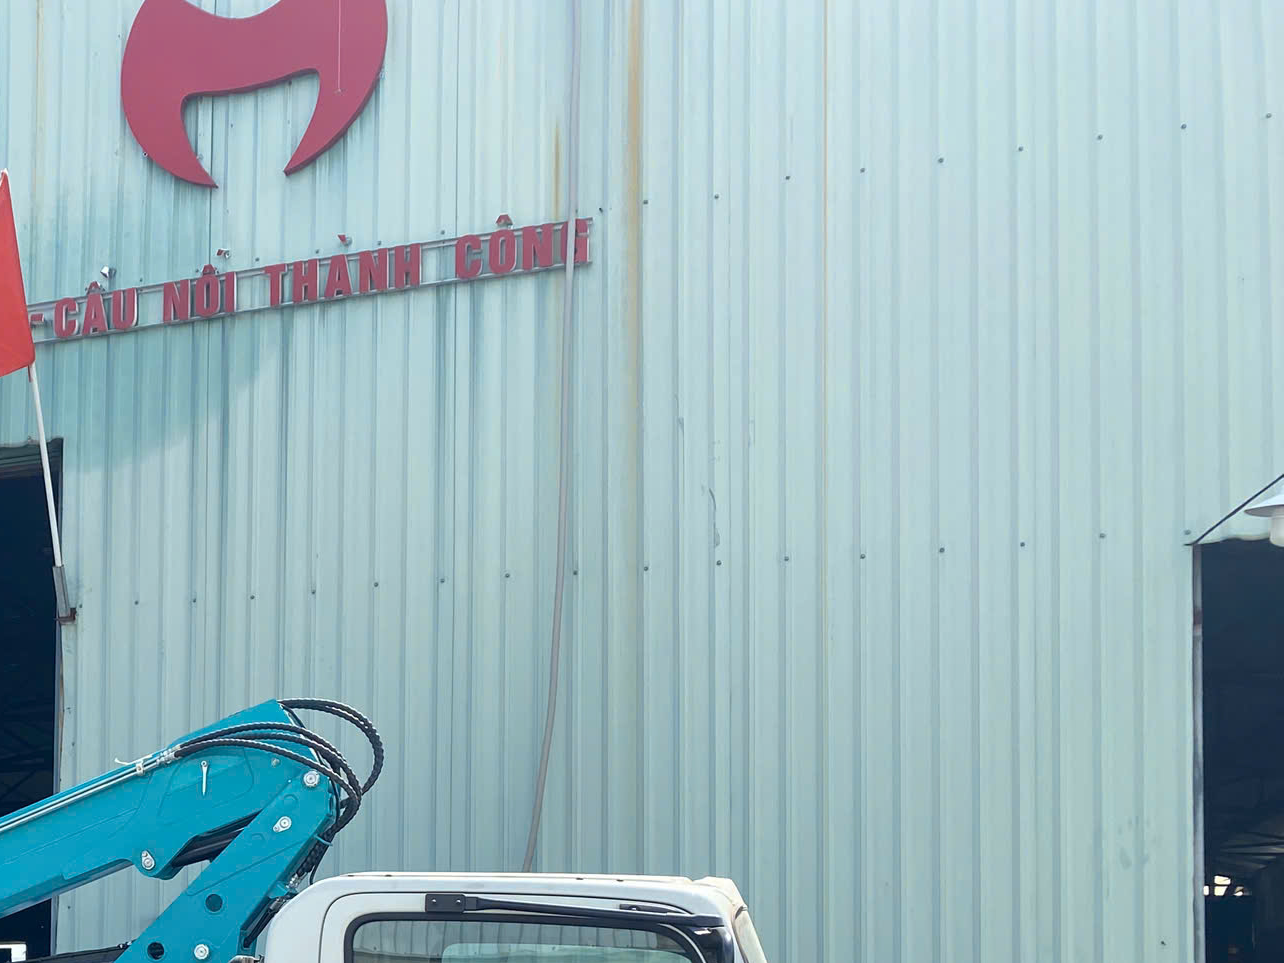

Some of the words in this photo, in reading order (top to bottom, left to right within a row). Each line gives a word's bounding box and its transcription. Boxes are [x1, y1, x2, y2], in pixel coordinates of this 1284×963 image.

[163, 248, 237, 323] NỐI
[264, 234, 422, 308] THÀNH
[454, 214, 589, 279] CÔNG
